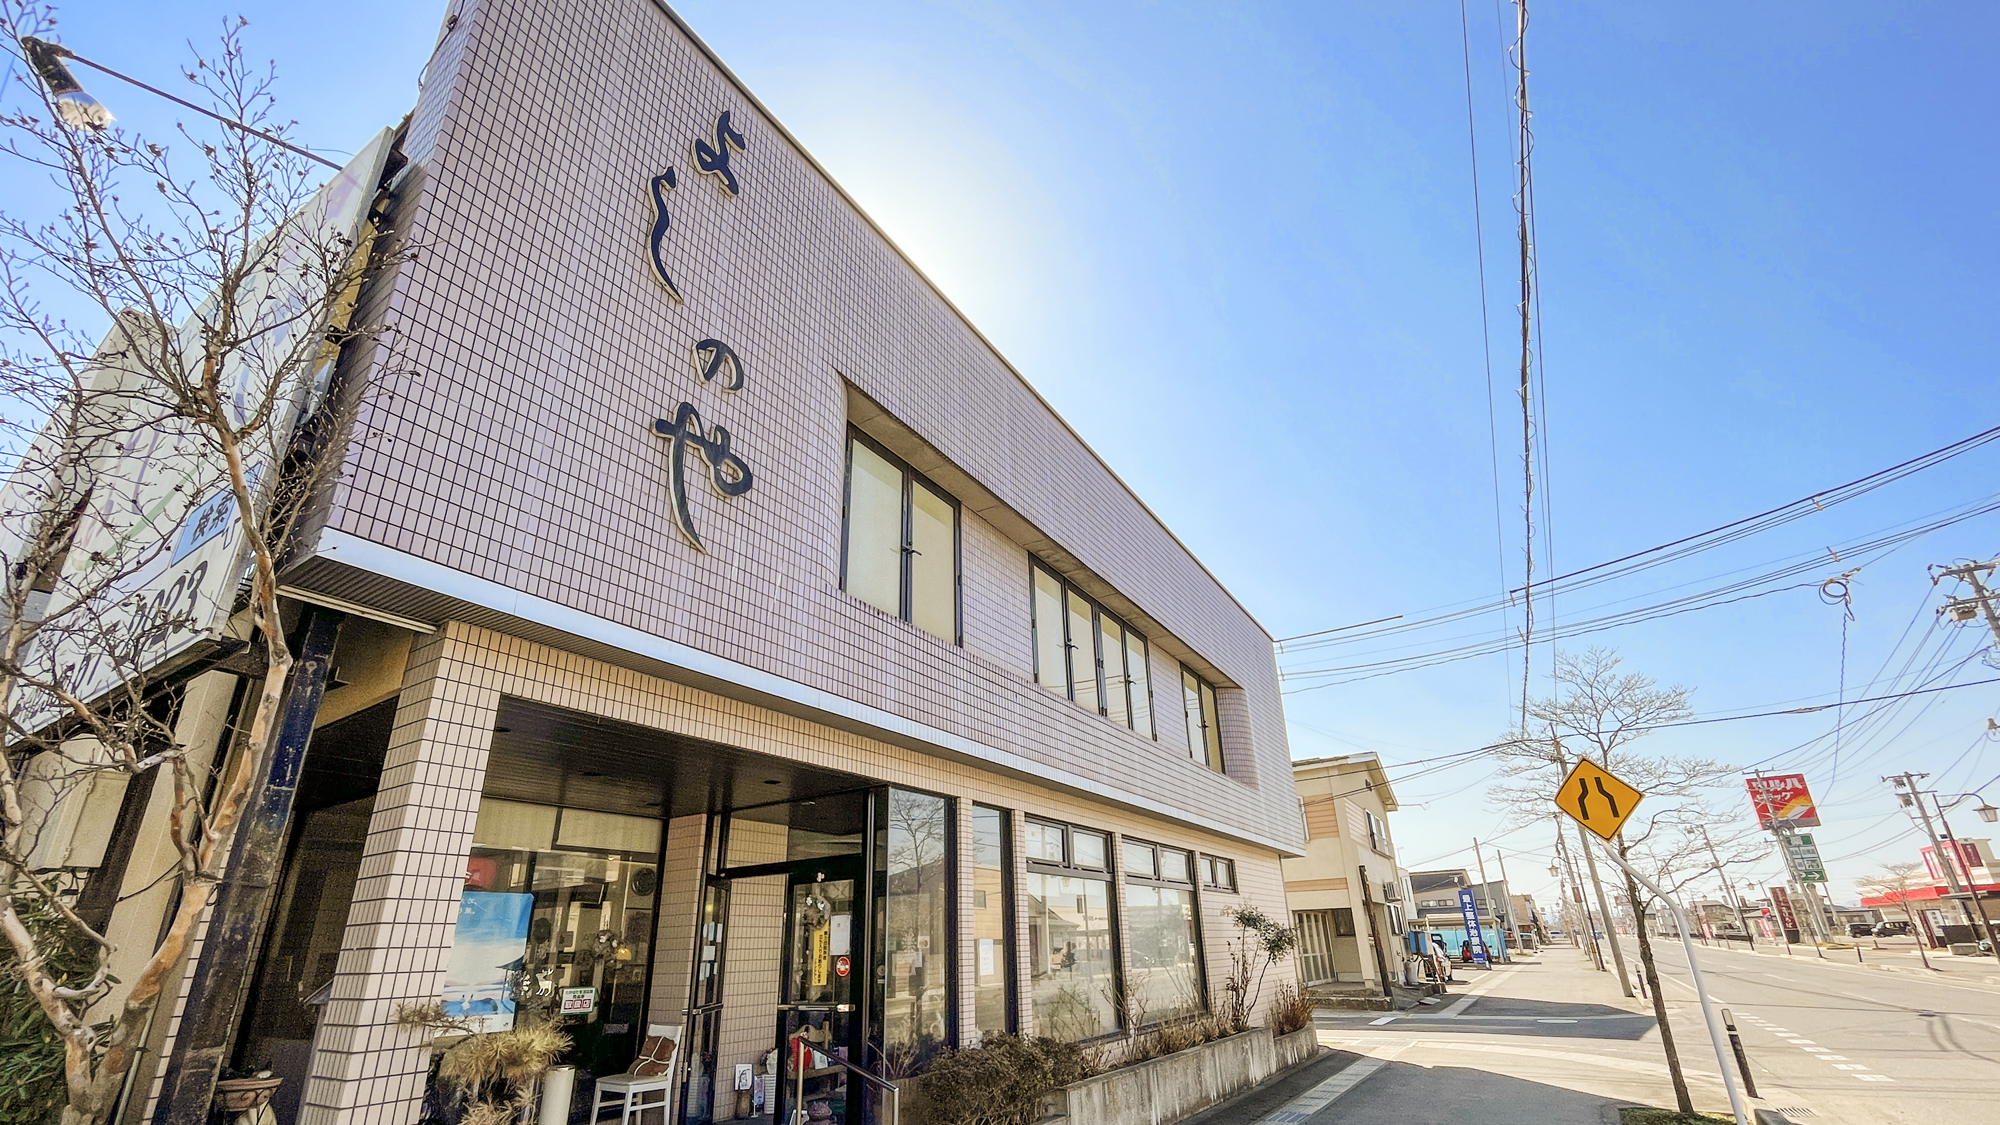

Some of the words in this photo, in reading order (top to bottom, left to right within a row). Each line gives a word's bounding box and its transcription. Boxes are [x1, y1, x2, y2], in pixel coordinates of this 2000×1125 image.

[647, 110, 753, 555] よしのや
[191, 493, 234, 545] 検索
